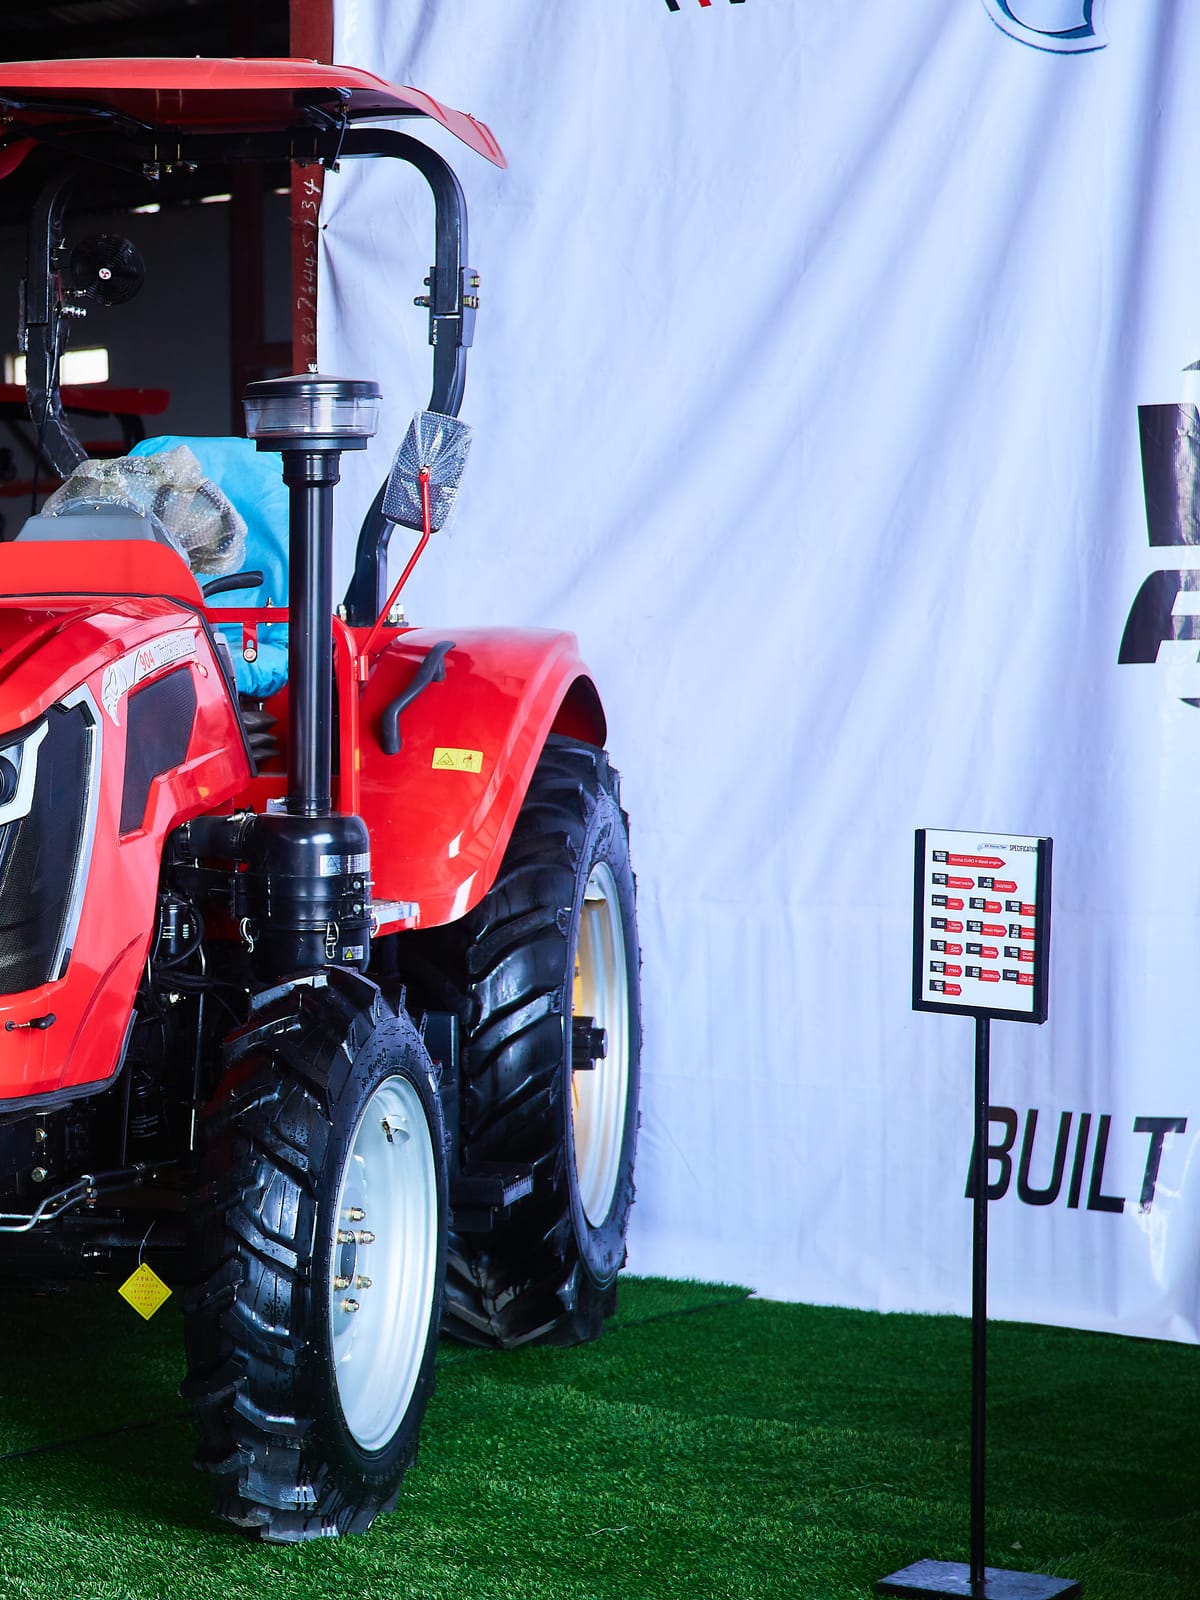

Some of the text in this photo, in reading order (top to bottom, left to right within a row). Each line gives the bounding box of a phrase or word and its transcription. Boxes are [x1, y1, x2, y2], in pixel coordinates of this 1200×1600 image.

[139, 649, 155, 671] 904
[1009, 844, 1037, 852] SPECIFICATIO
[964, 1106, 1188, 1214] BUILT
